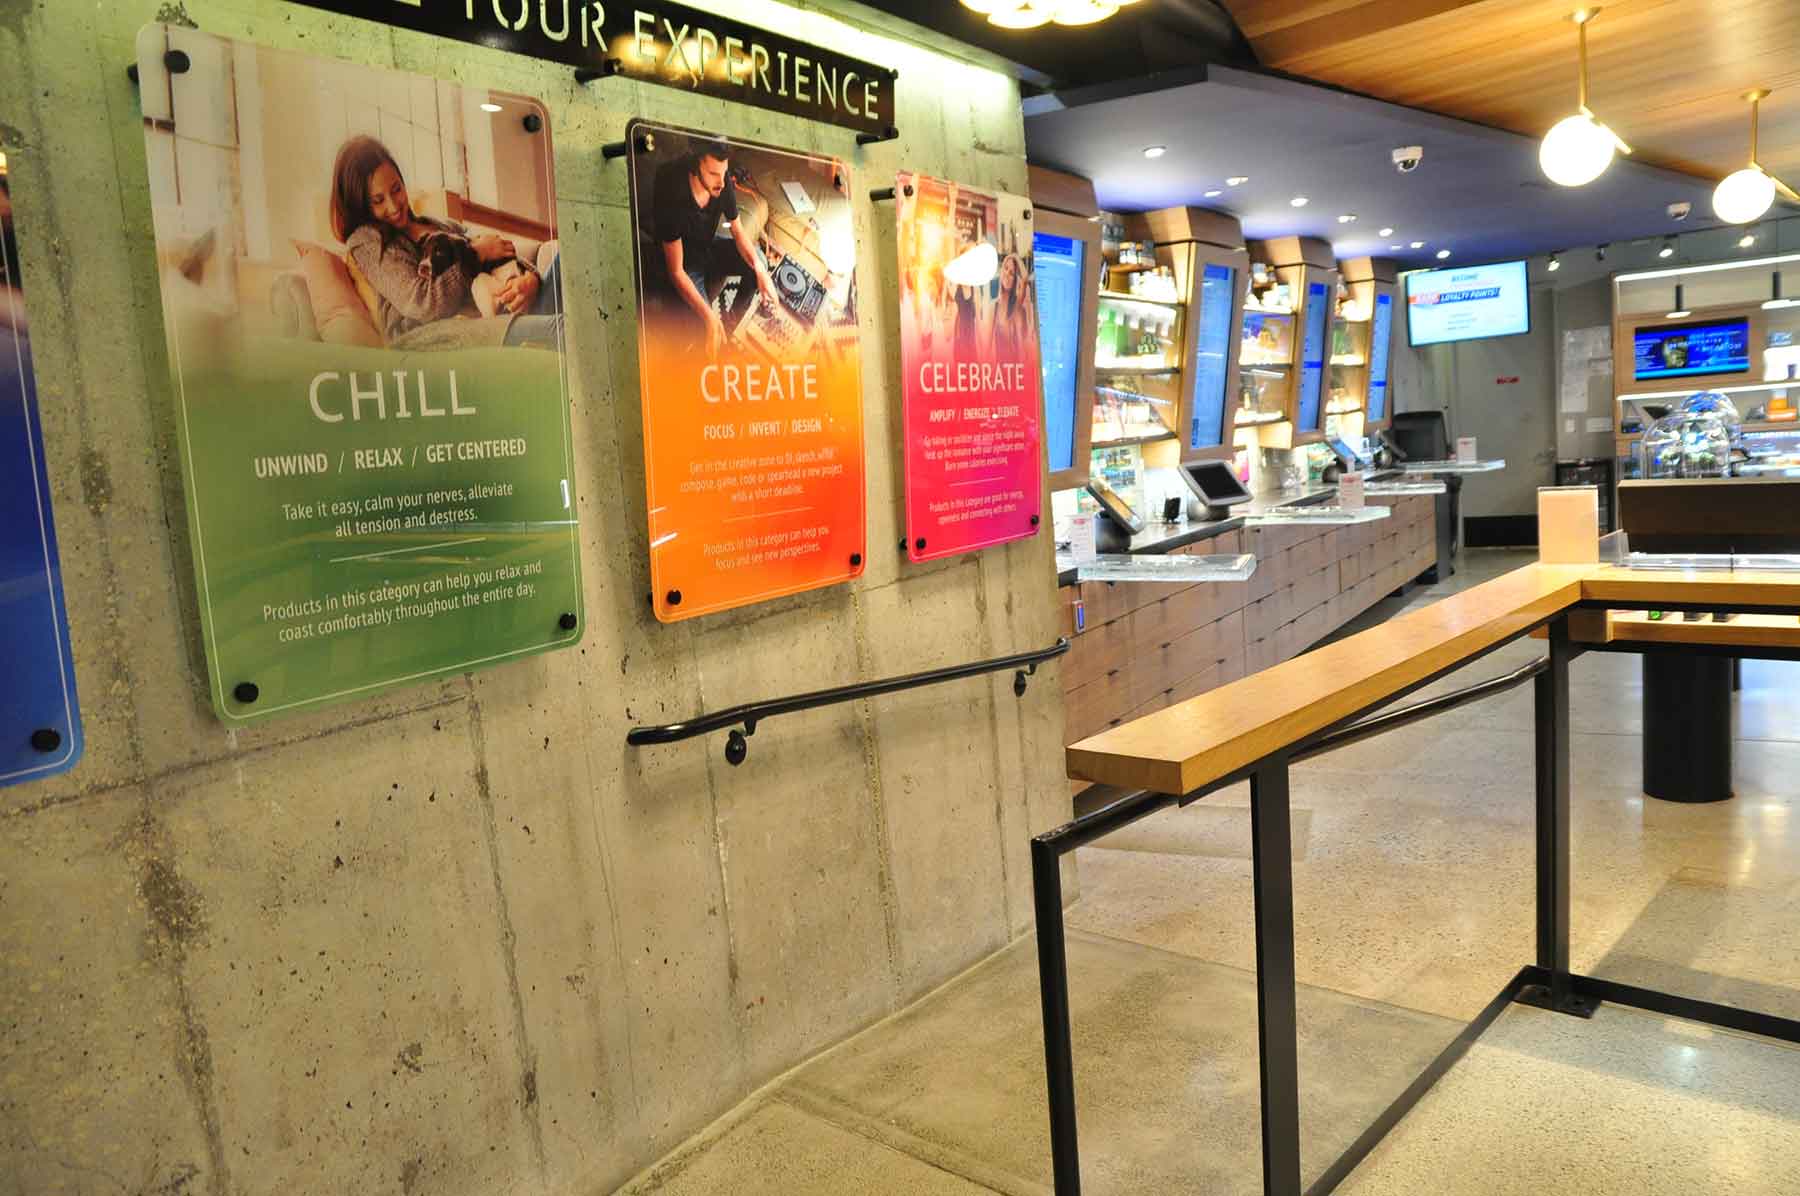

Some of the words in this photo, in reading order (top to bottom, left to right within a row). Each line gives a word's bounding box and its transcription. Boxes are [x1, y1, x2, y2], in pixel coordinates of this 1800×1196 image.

[633, 9, 880, 119] EXPERIENCE
[309, 369, 476, 423] CHILL
[701, 364, 818, 403] CREATE
[920, 362, 1025, 393] CELEBRATE
[704, 423, 736, 440] FOCUS
[749, 421, 780, 437] INVENT
[791, 418, 822, 433] DESIGN
[929, 408, 956, 422] AMPLIFY
[254, 453, 328, 478] UNWIND
[355, 447, 403, 470] RELAX
[426, 443, 454, 463] GET
[457, 438, 526, 460] CENTERED
[282, 503, 313, 521] Take
[318, 502, 327, 517] it
[331, 499, 363, 518] easy,
[365, 495, 394, 513] calm
[397, 493, 423, 512] your
[426, 488, 467, 505] nerves,
[468, 483, 513, 499] alleviate
[335, 521, 352, 537] all
[356, 517, 401, 535] tension
[404, 512, 426, 529] and
[429, 508, 478, 527] destress.
[263, 602, 322, 621] Products
[326, 595, 337, 612] in
[342, 591, 366, 608] this
[369, 581, 420, 605] category
[423, 580, 442, 593] can
[446, 571, 470, 590] help
[473, 571, 492, 588] you
[495, 566, 521, 581] relax
[523, 560, 542, 576] and
[279, 624, 315, 642] coast
[318, 607, 393, 634] comfortably
[395, 596, 459, 621] throughout
[462, 591, 480, 607] the
[483, 586, 513, 604] entire
[516, 582, 536, 599] day.
